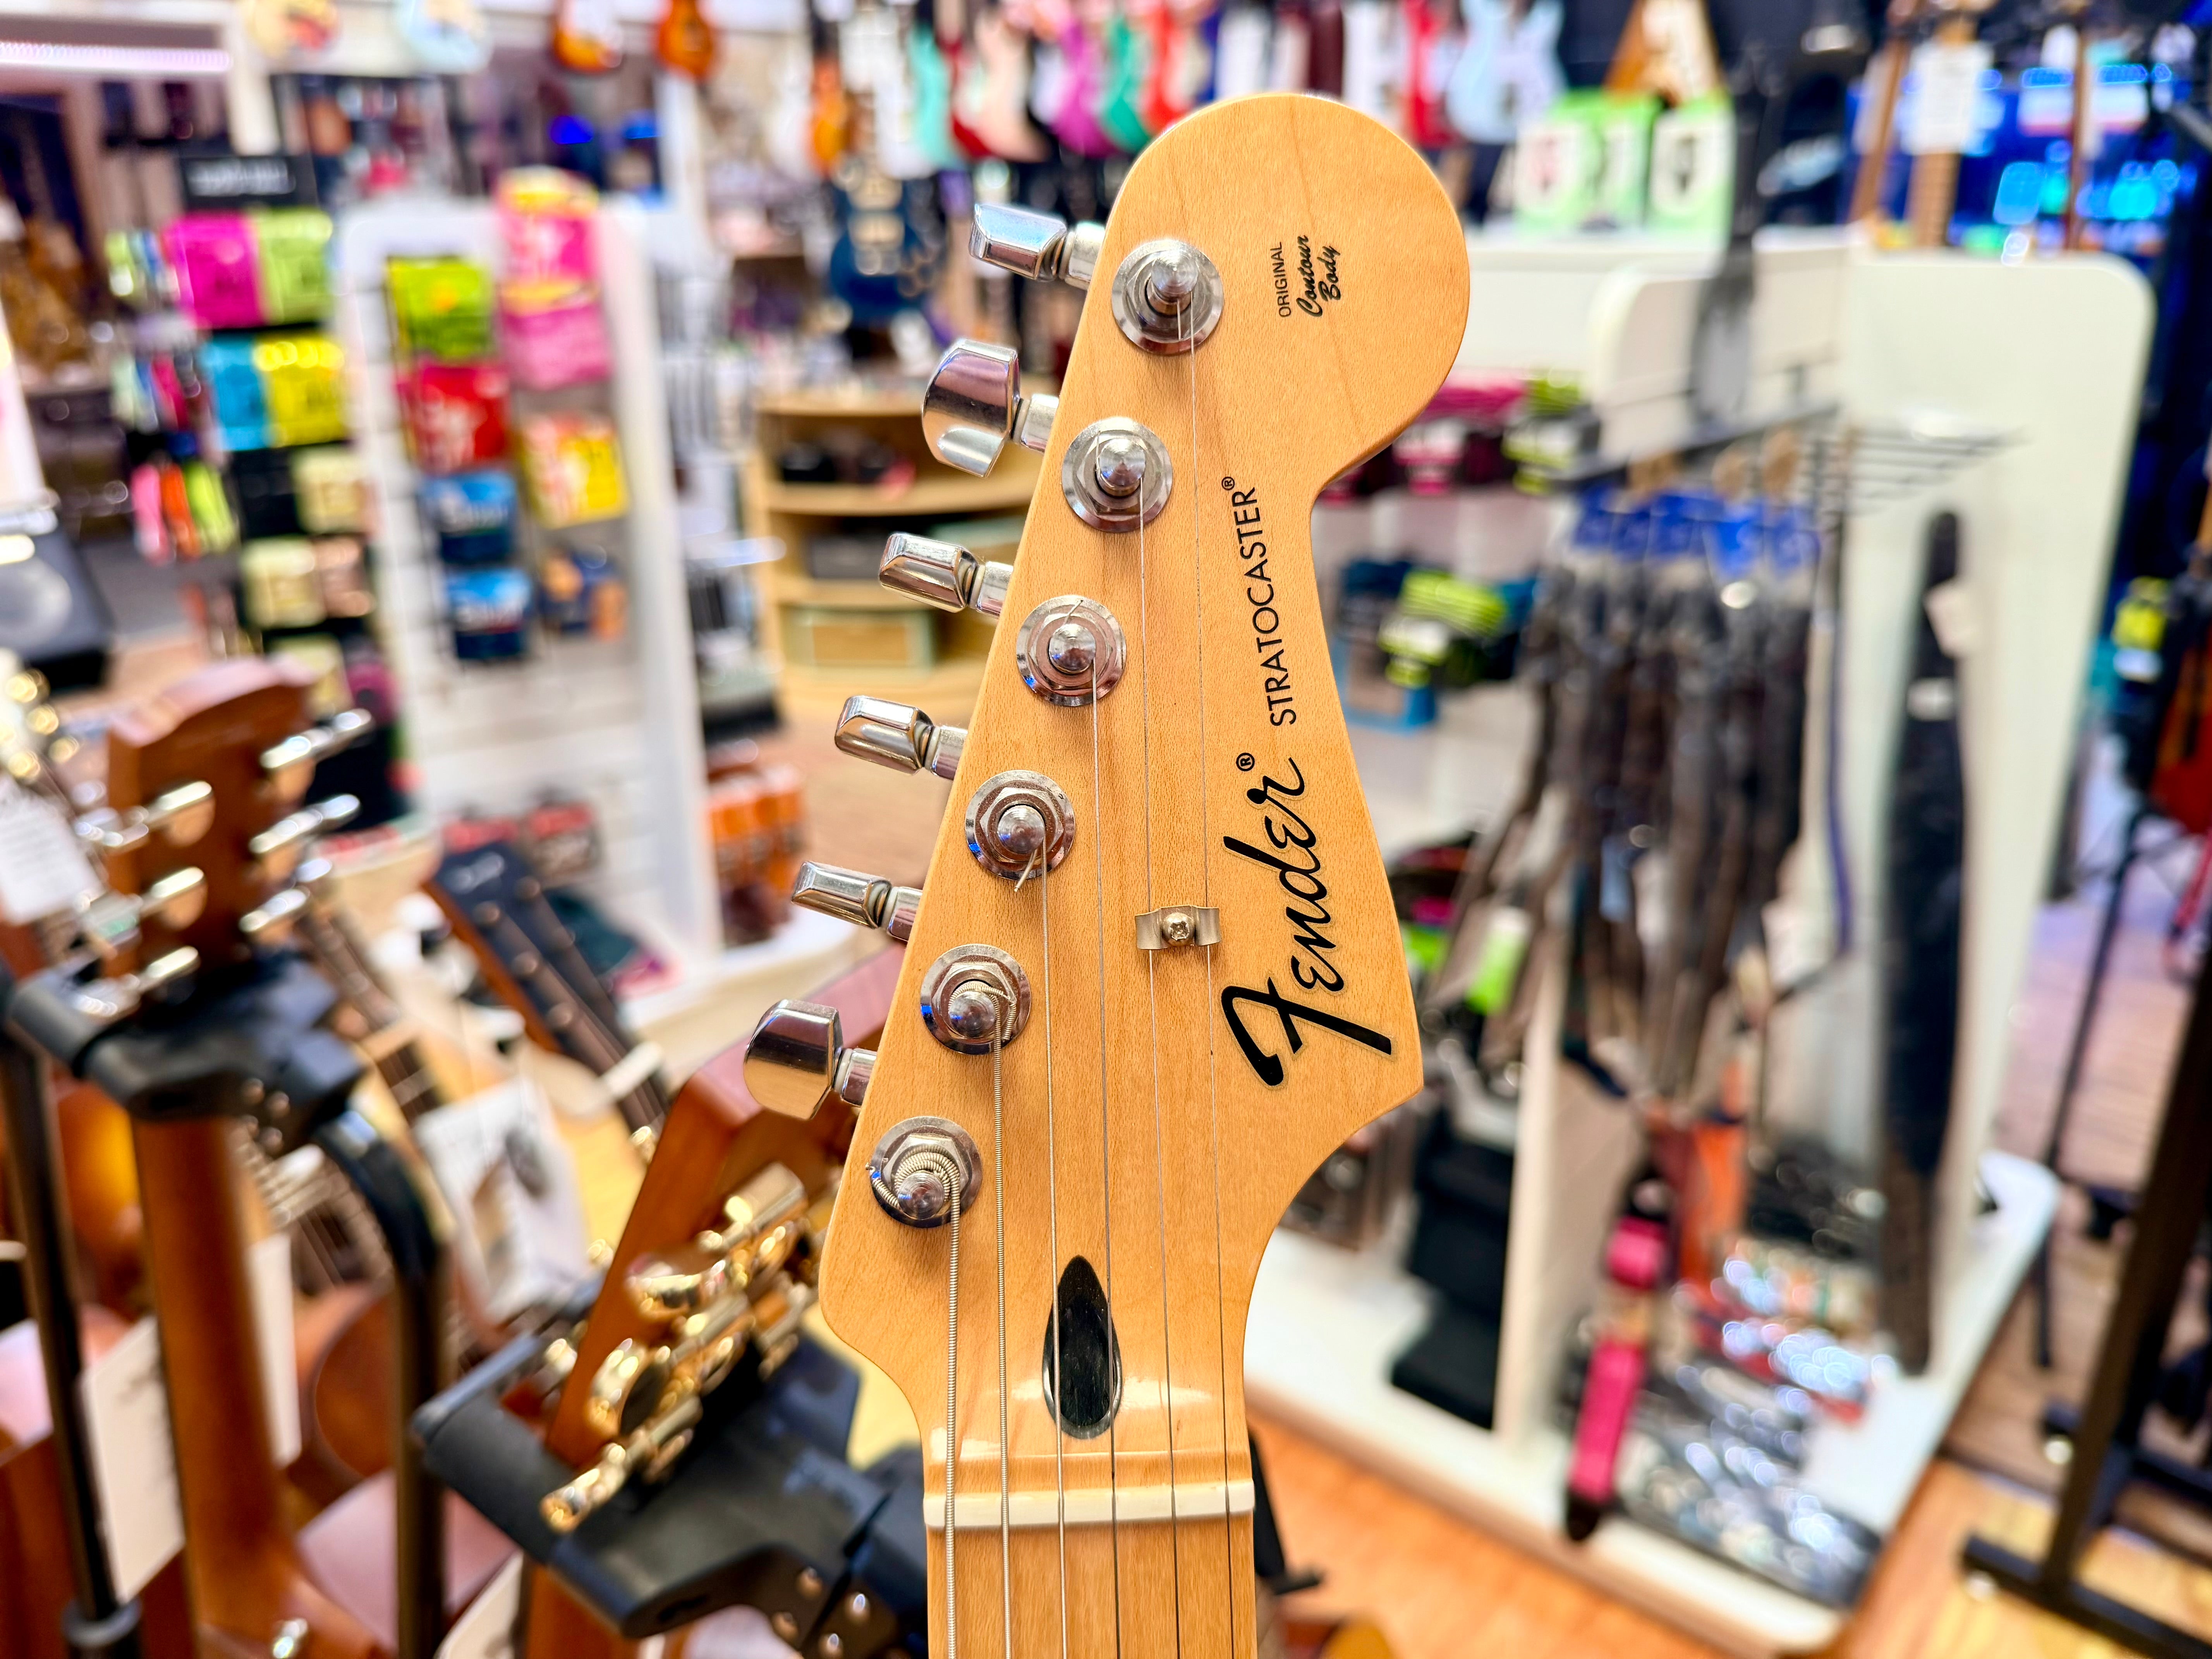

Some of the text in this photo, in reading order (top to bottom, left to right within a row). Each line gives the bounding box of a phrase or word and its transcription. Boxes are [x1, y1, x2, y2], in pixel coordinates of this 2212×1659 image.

[1270, 242, 1291, 317] ORIGINAL
[1296, 235, 1323, 317] Contour
[1317, 246, 1341, 301] Body
